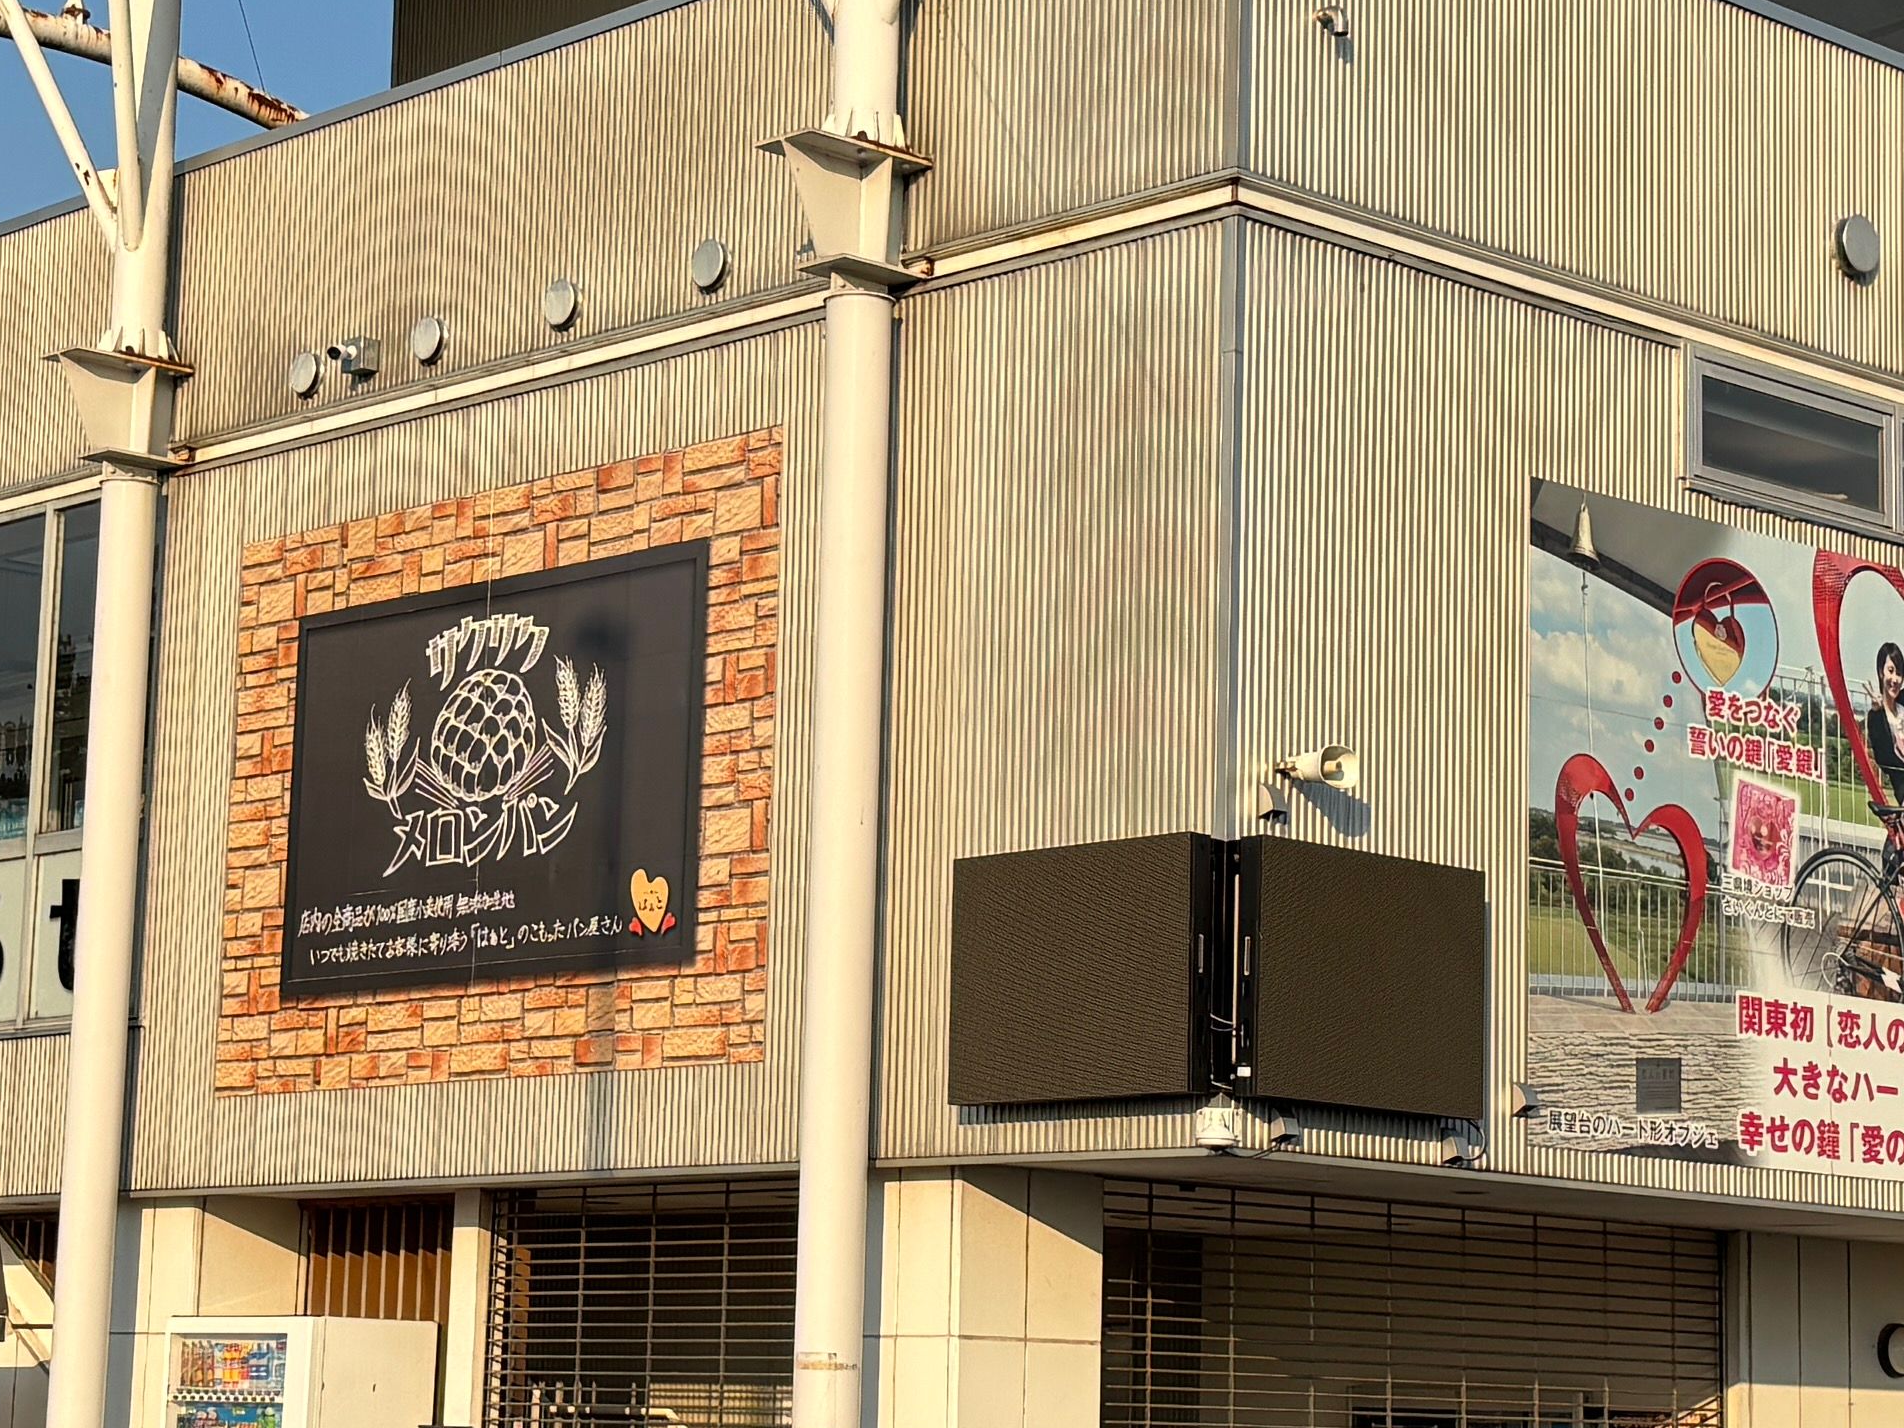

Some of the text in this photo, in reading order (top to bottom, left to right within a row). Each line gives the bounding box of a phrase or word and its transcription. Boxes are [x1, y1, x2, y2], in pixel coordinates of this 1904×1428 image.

[426, 613, 550, 691] サクサク
[1706, 690, 1801, 734] 愛をつなぐ
[1688, 727, 1826, 782] 誓いの鍵「愛鍵」
[382, 792, 578, 878] メロンパン
[1547, 1110, 1720, 1149] 展望台のハート形オブジェ
